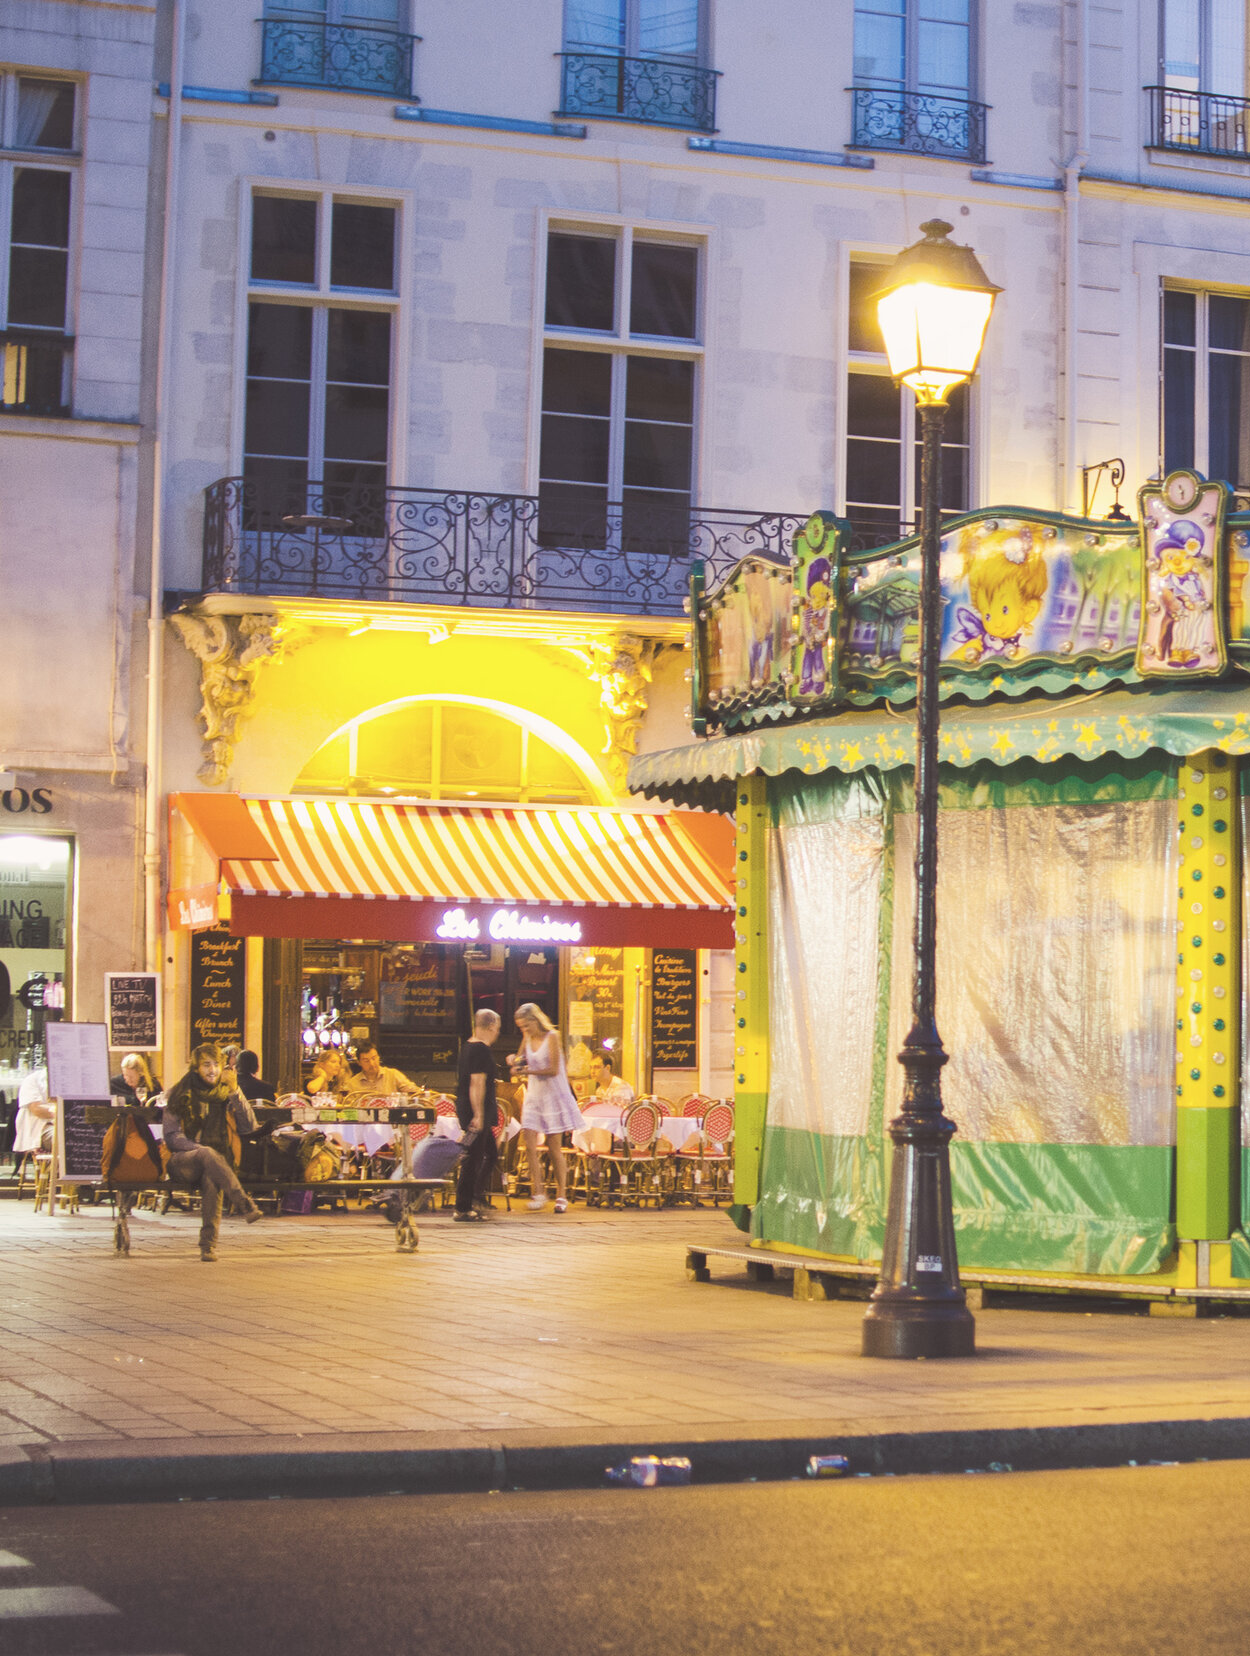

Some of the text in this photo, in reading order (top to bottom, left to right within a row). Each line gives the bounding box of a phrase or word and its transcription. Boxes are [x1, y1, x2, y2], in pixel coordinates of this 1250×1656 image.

[0, 787, 53, 814] OS
[0, 899, 43, 920] ING
[436, 907, 481, 939] Les
[199, 939, 242, 955] Breakfast
[201, 957, 234, 967] Brunch
[654, 954, 684, 965] Cuisine
[202, 976, 232, 988] Lunch
[656, 977, 691, 989] Burgers
